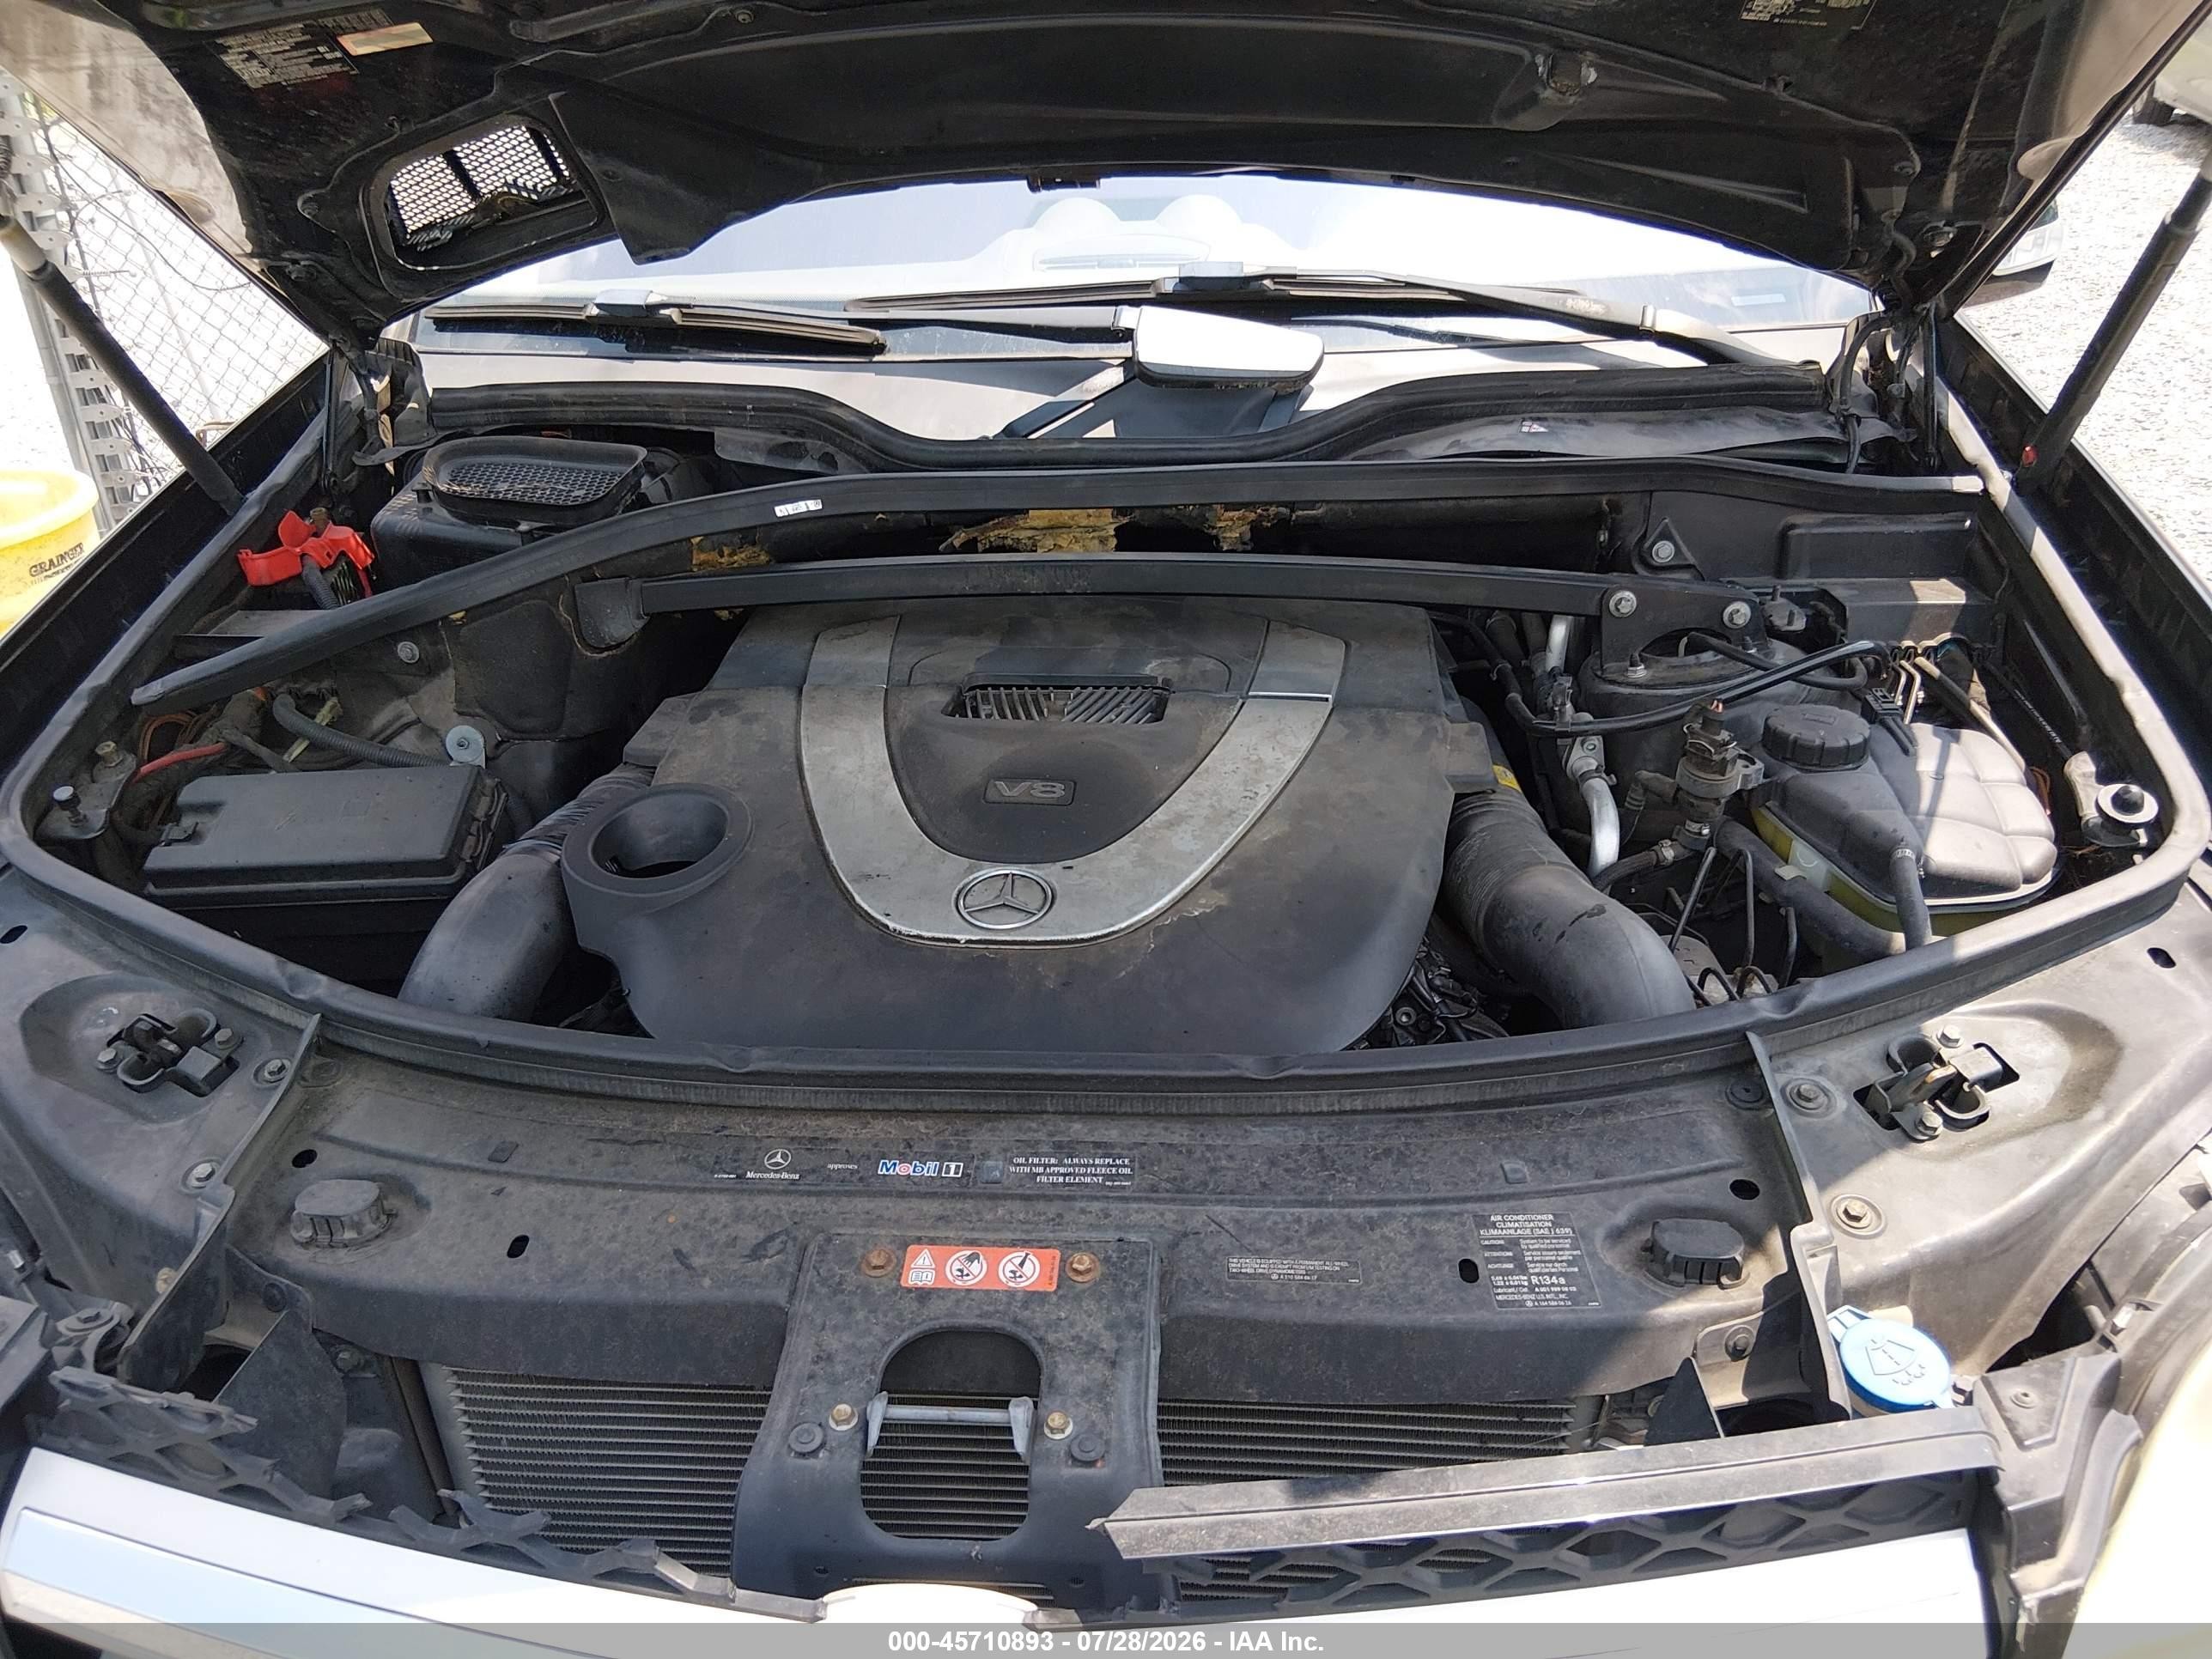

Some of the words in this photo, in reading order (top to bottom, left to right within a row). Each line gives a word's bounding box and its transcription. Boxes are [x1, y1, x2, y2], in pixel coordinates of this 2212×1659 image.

[994, 781, 1066, 799] V8
[878, 1159, 940, 1176] Mobil
[745, 1170, 800, 1180] Mercedes-Benz
[1530, 1275, 1566, 1285] R134a
